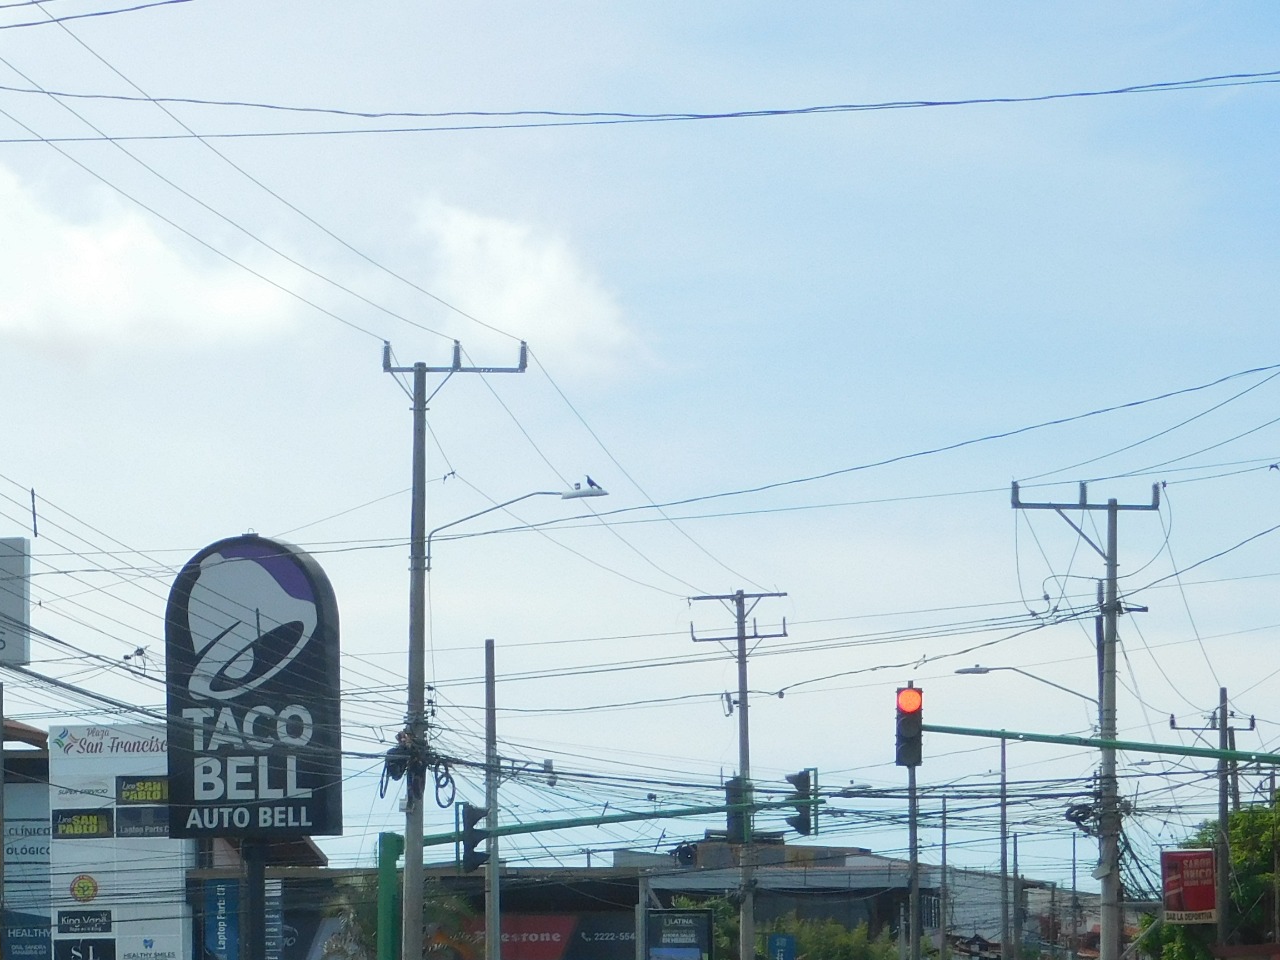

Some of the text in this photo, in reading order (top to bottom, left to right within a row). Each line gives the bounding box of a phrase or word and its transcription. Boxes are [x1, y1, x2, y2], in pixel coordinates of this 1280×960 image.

[182, 704, 313, 751] TACO
[86, 727, 110, 740] Plaza
[77, 735, 168, 754] San Francisc
[193, 754, 313, 800] BELL
[136, 781, 162, 791] SAN
[121, 790, 162, 801] PABLO
[71, 815, 98, 825] SAN
[185, 806, 313, 829] AUTO BELL
[57, 824, 98, 834] PABLO
[6, 845, 50, 855] OLÓGIC
[61, 916, 81, 928] King
[7, 929, 51, 938] HEALTHY
